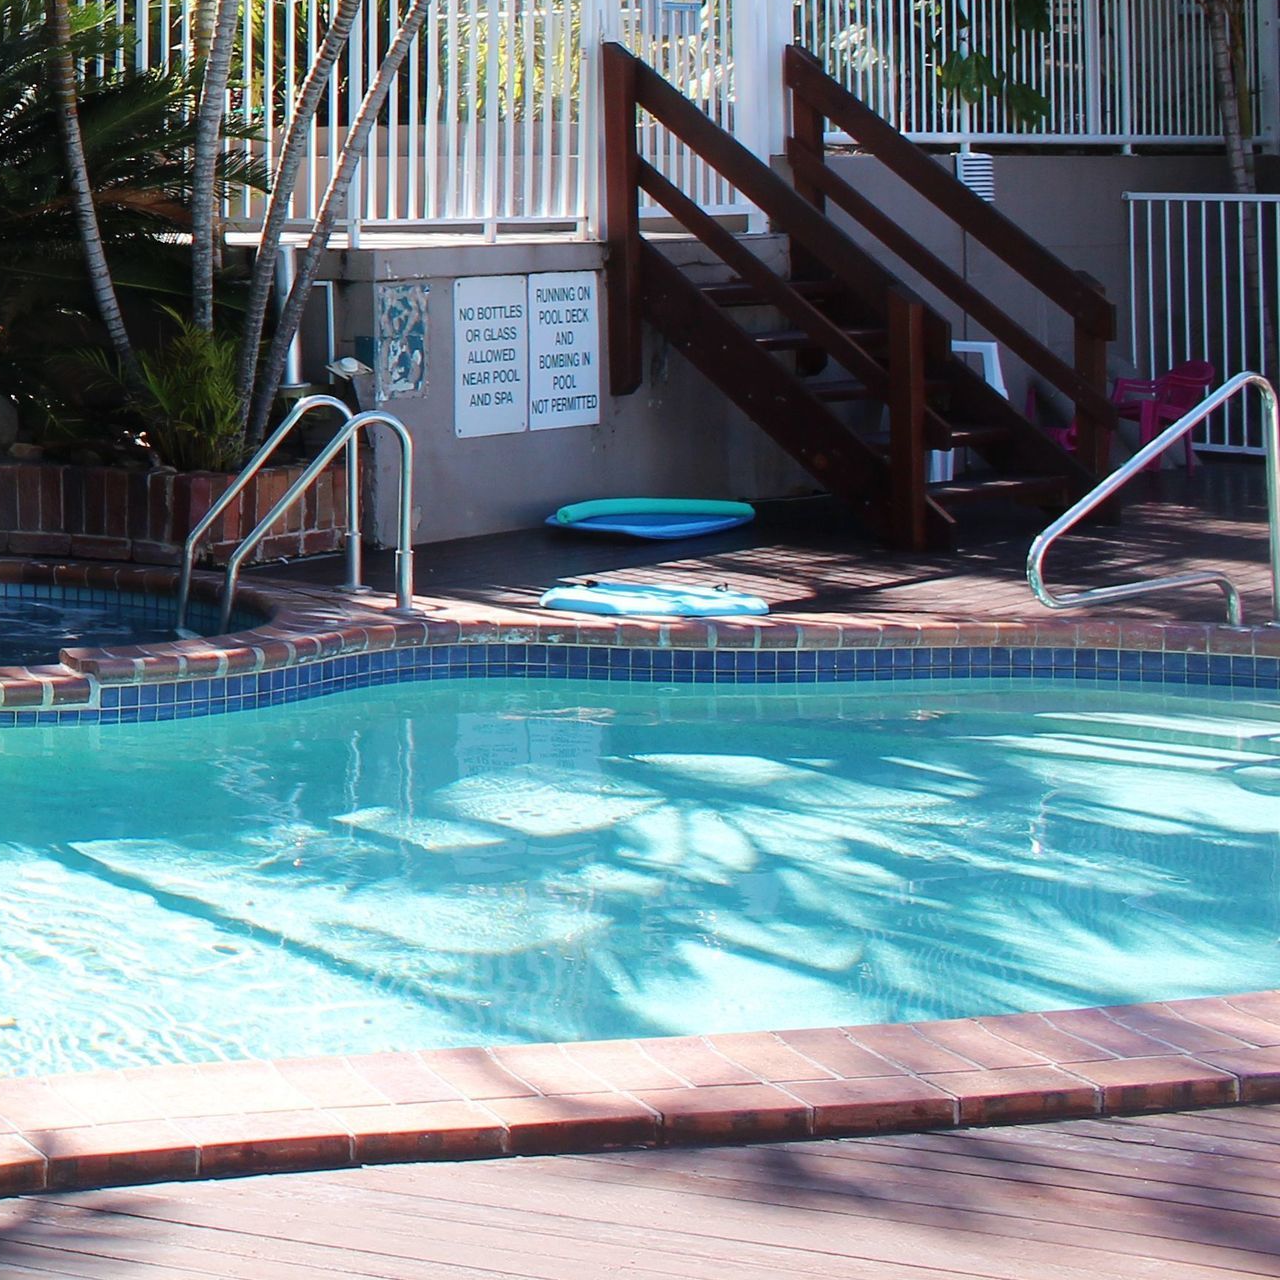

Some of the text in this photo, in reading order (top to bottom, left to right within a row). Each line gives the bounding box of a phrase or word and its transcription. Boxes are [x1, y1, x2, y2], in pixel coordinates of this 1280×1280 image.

[536, 286, 590, 303] RUNNING ON
[459, 305, 522, 321] NO BOTTLES
[539, 308, 589, 324] POOL DECK
[466, 326, 517, 342] OR GLASS
[555, 331, 574, 345] AND
[467, 347, 515, 364] ALLOWED
[539, 351, 590, 369] BOMBING IN
[462, 369, 520, 386] NEAR POOL
[553, 374, 576, 390] POOL
[469, 391, 513, 407] AND SPA
[531, 394, 597, 414] NOT PERMITTED
